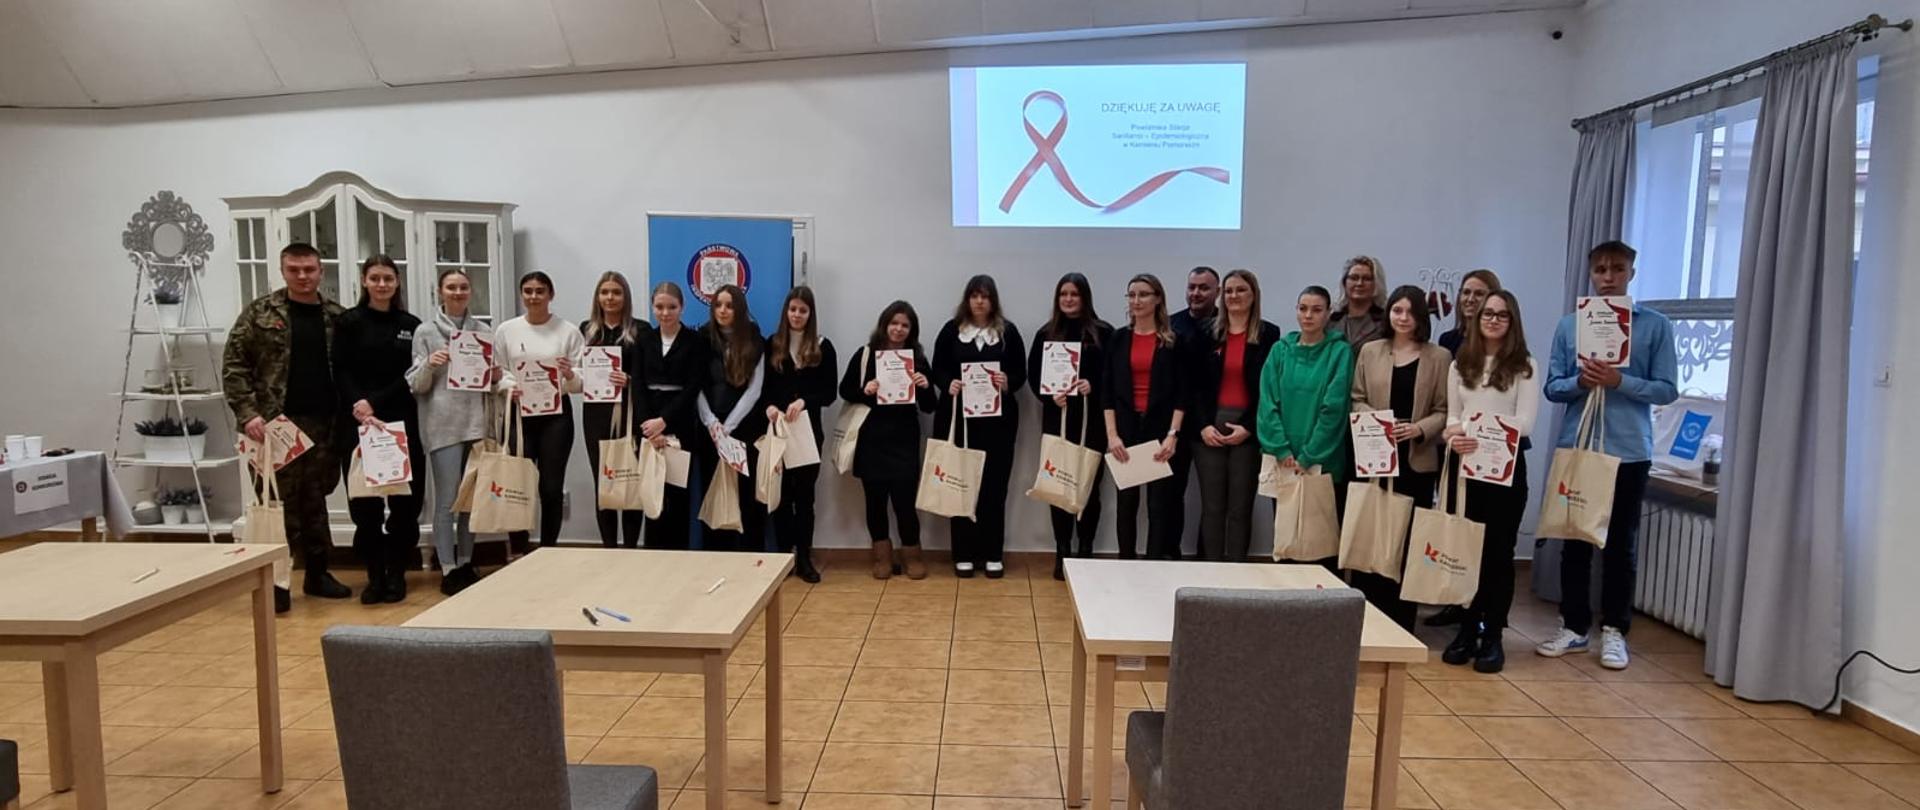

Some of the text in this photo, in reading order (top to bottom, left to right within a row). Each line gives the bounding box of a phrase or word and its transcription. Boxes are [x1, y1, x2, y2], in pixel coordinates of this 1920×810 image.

[1101, 102, 1221, 115] DZIĘKUJĘ ZA UWAGĘ
